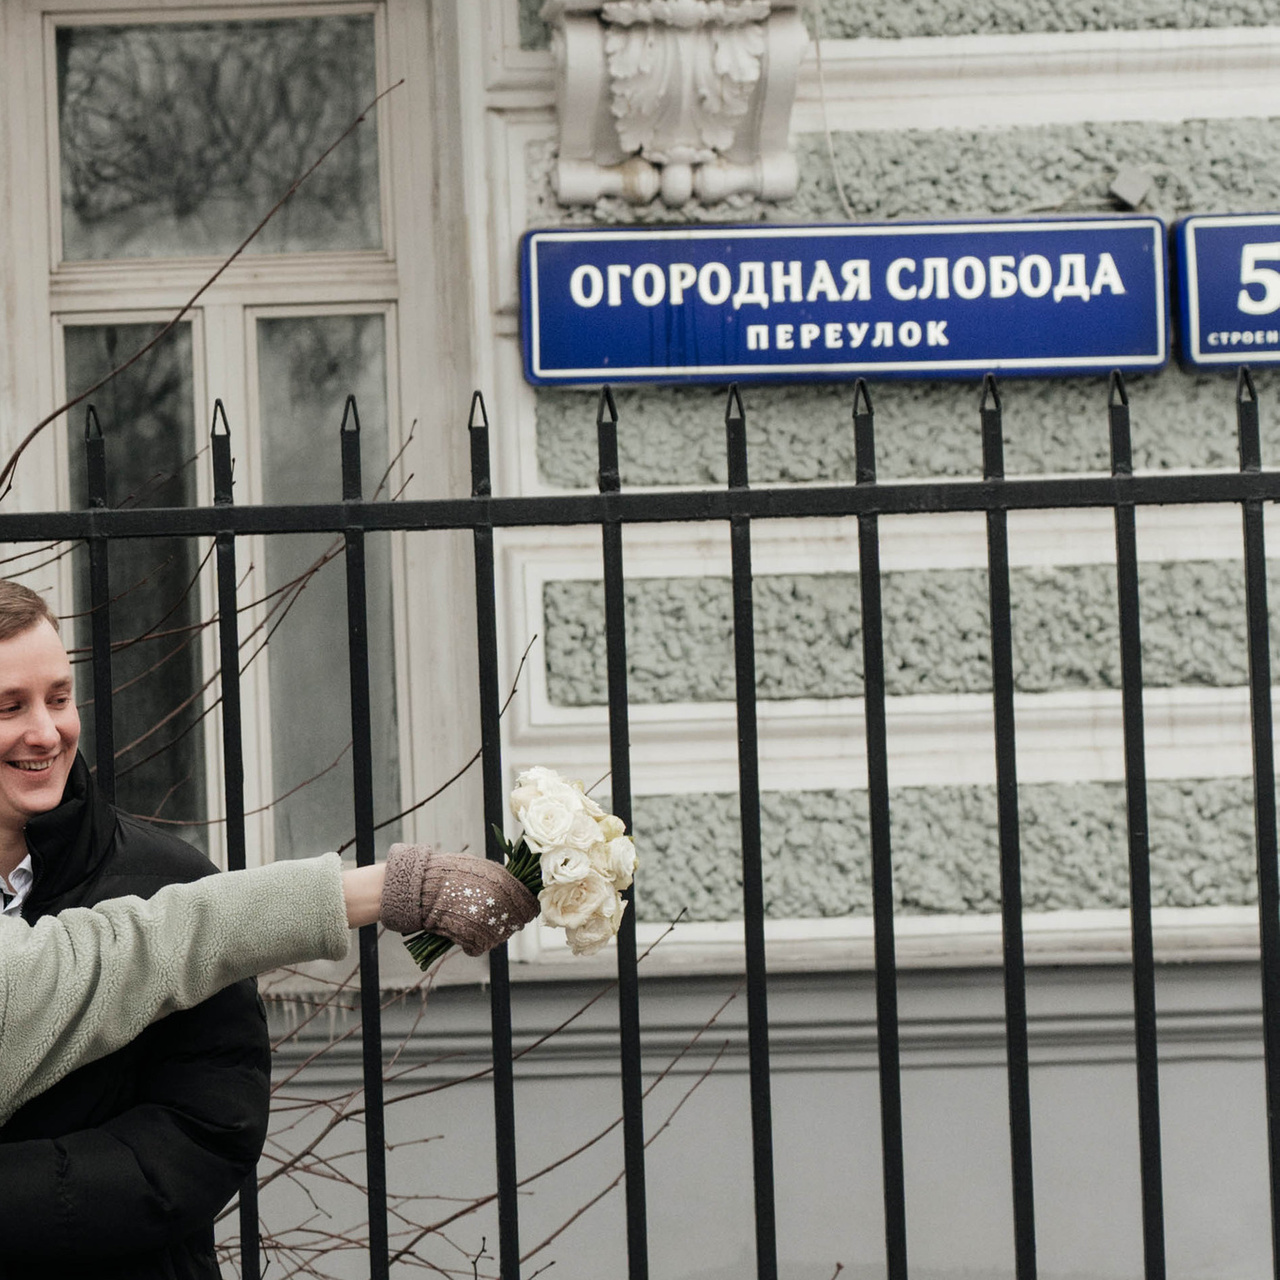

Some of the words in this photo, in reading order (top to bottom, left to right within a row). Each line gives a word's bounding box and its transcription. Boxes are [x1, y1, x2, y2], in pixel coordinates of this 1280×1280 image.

[569, 260, 872, 310] ОГОРОДНАЯ
[885, 252, 1126, 303] СЛОБОДА
[746, 320, 951, 350] ПЕРЕУЛОК
